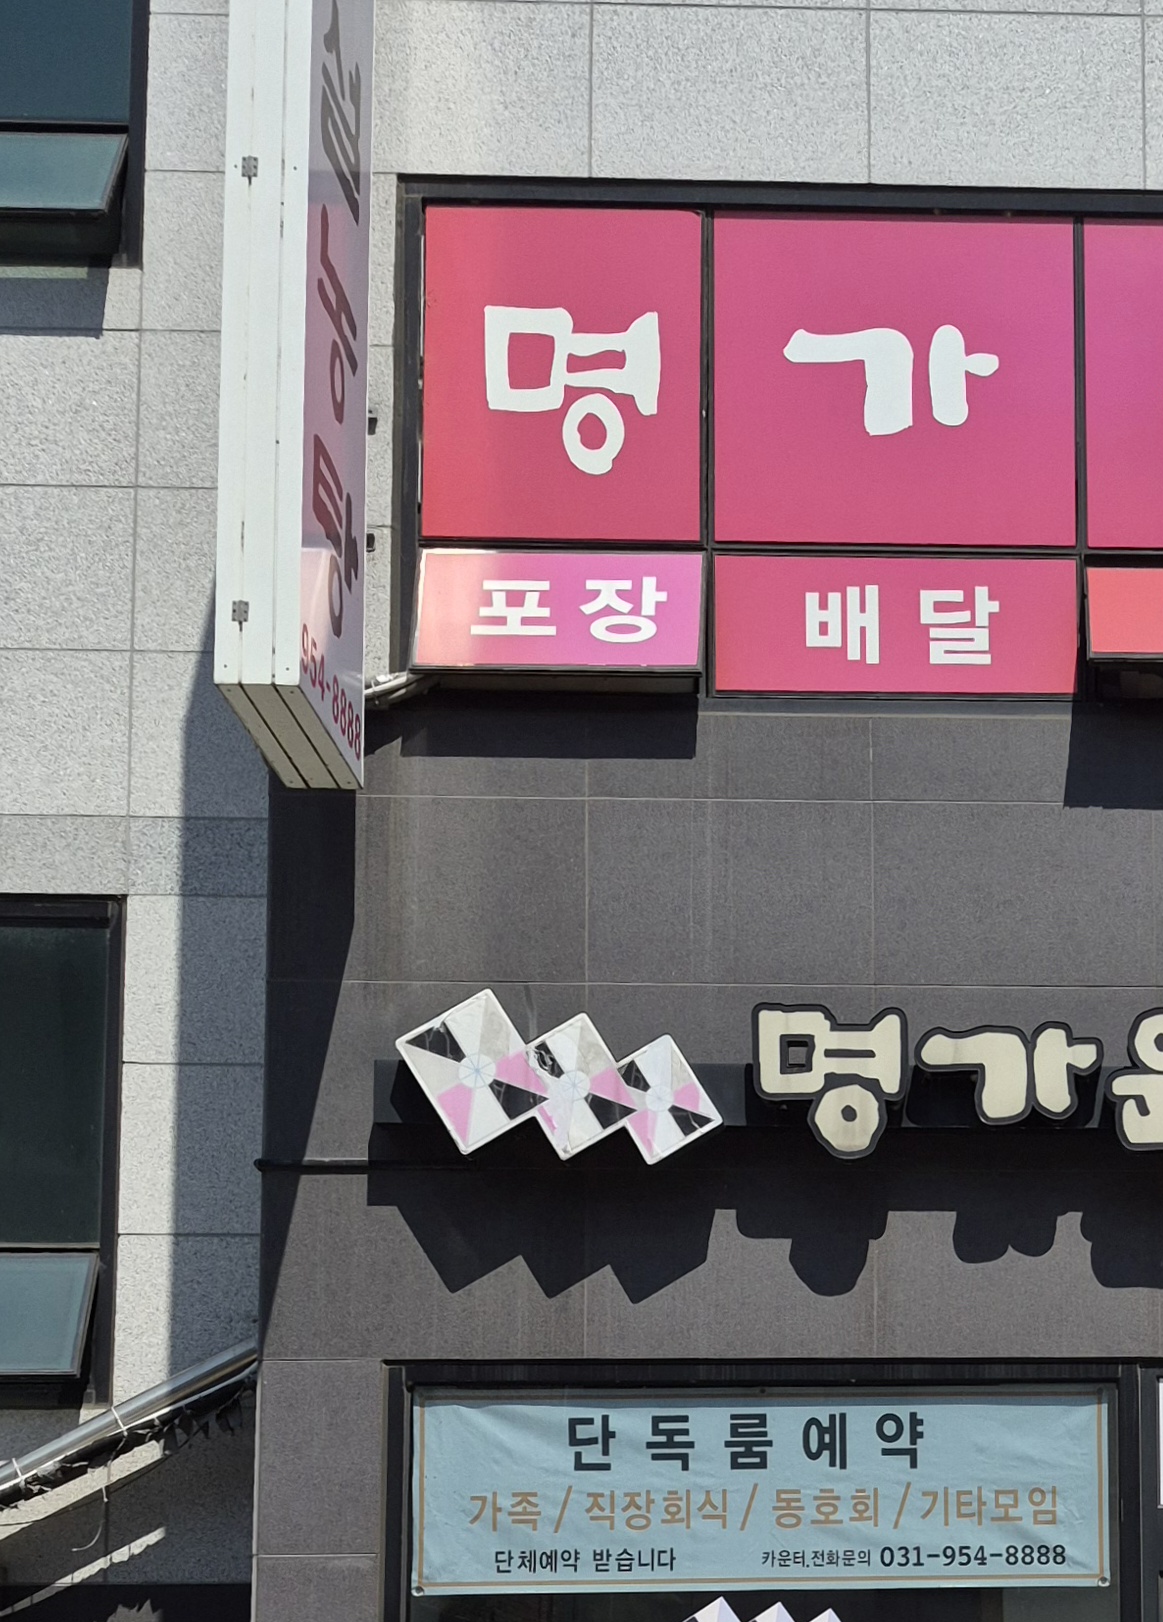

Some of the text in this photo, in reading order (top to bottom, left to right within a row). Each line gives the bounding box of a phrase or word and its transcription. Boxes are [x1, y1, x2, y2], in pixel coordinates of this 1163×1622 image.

[470, 575, 668, 643] 포장
[804, 584, 1001, 666] 배달
[302, 623, 361, 761] 954-8888
[494, 1548, 581, 1574] 단체예약
[592, 1547, 677, 1573] 받습니다
[879, 1544, 1068, 1568] 031-954-8888
